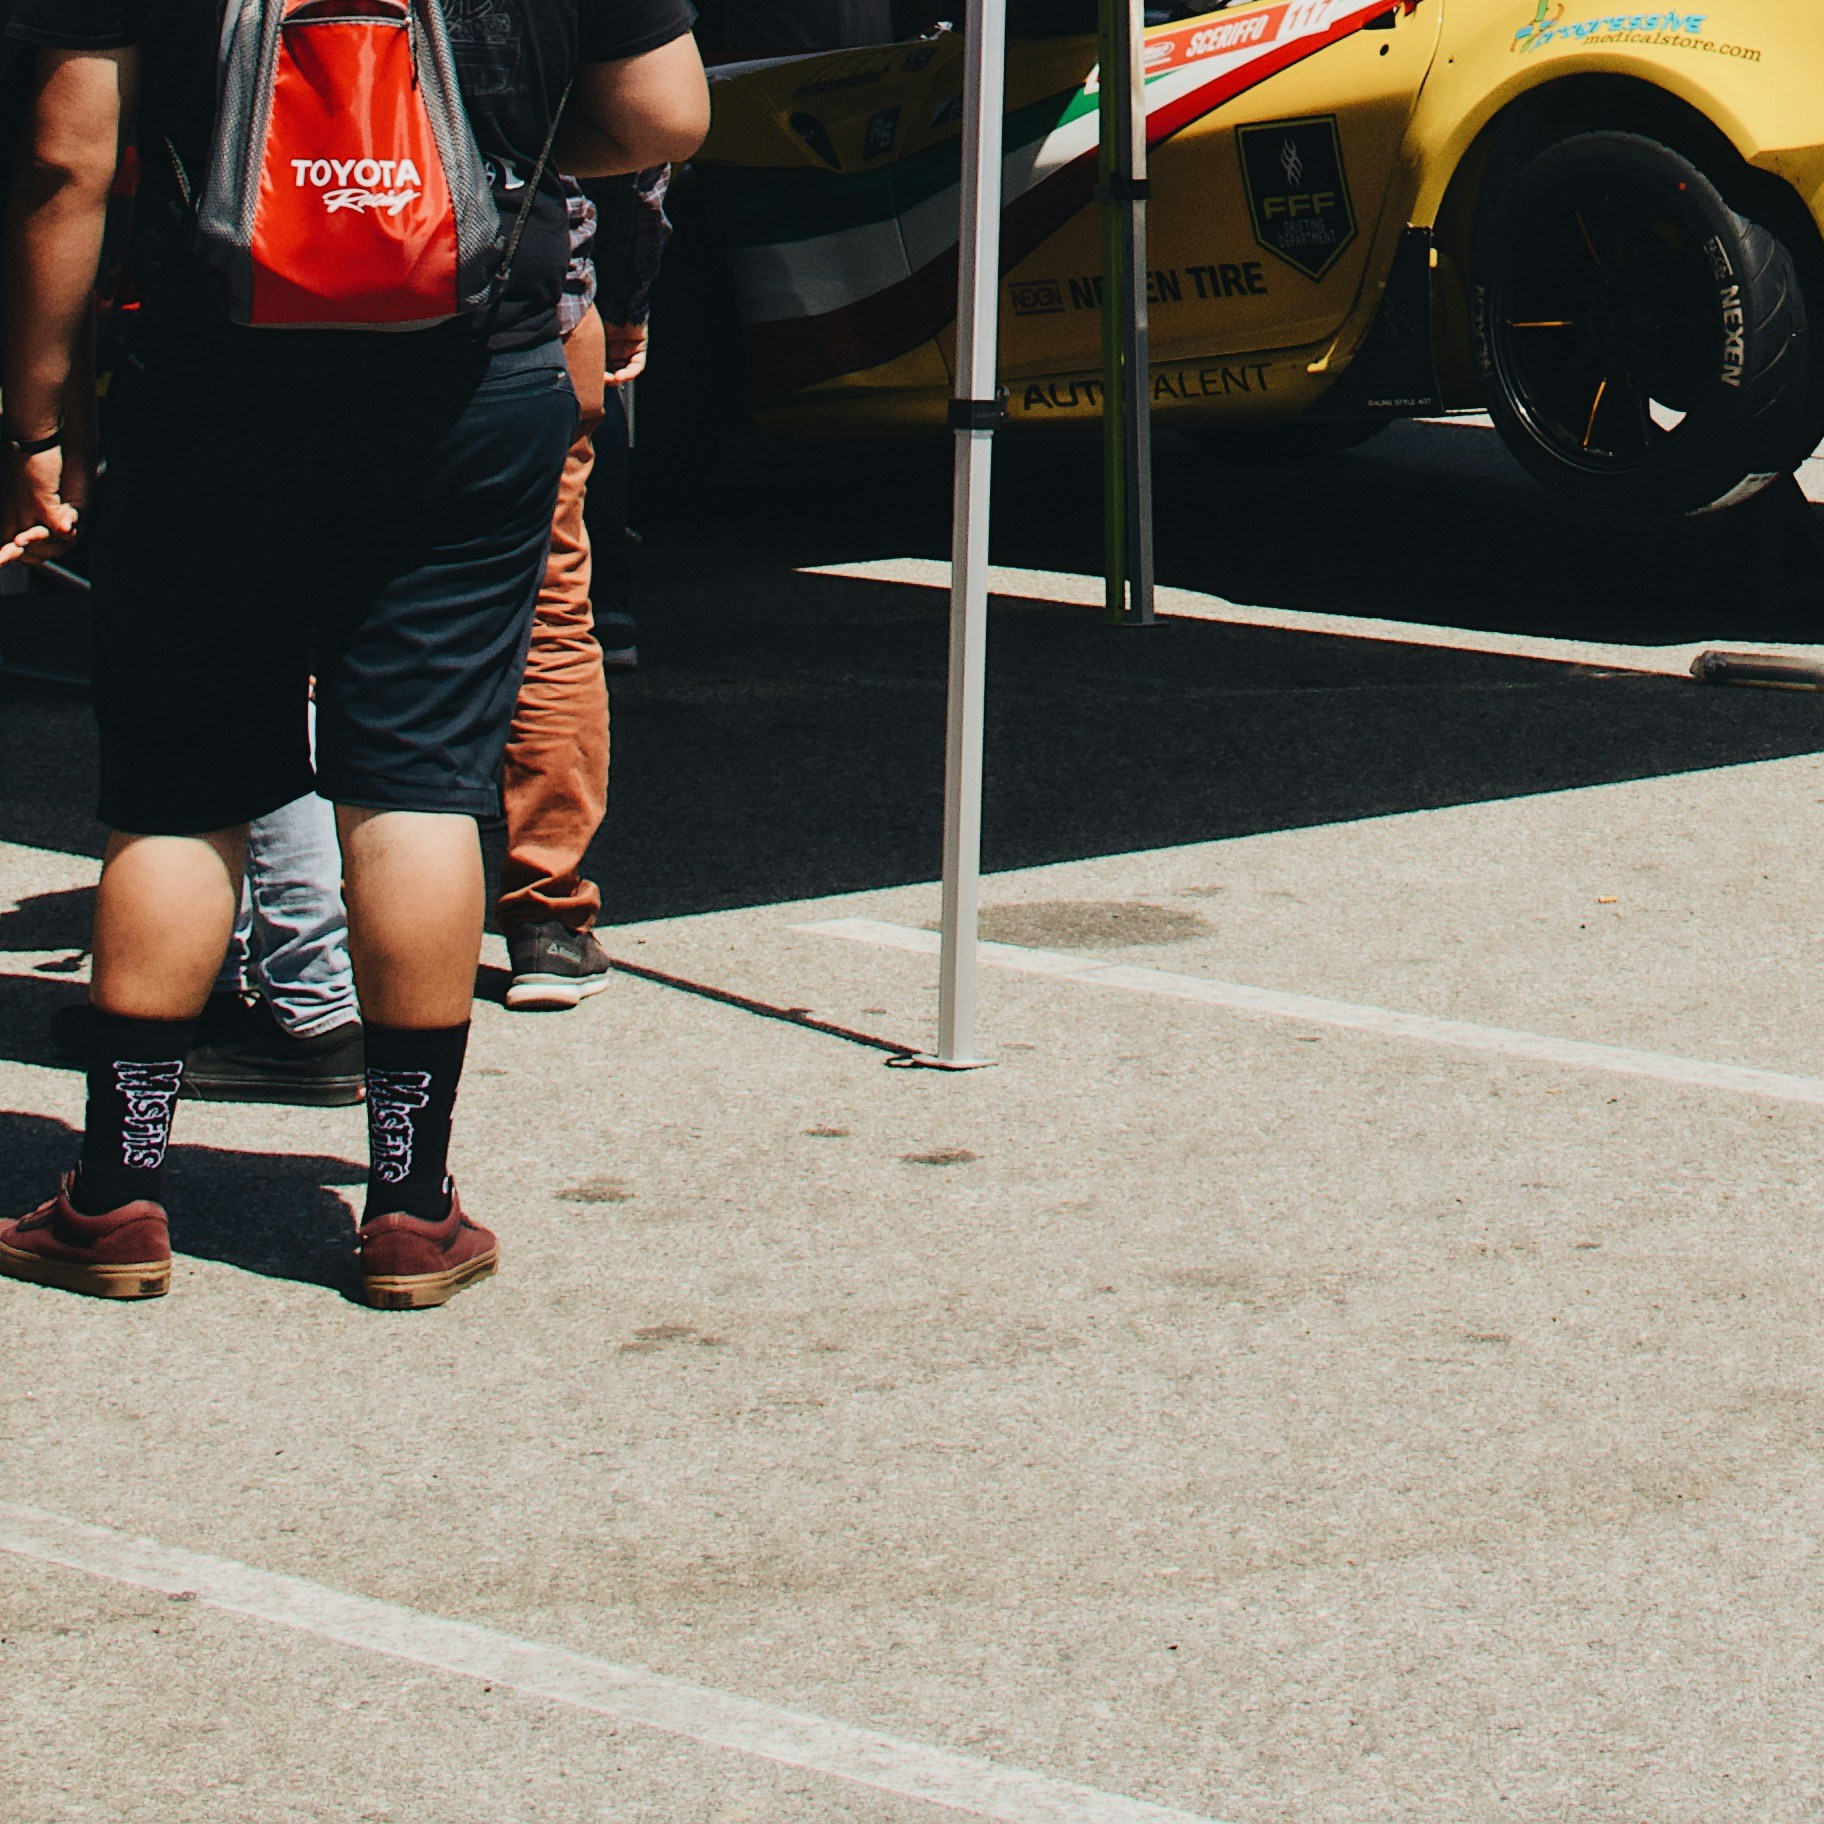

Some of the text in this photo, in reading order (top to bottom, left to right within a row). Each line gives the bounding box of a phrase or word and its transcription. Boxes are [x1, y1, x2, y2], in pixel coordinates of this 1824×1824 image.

[1184, 13, 1270, 58] SCERIFFO
[1583, 30, 1763, 63] medicalstore.com
[290, 158, 422, 188] TOYOTA
[321, 188, 422, 216] Racing
[1263, 191, 1337, 220] FFF
[1185, 260, 1268, 300] TIRE
[1719, 284, 1746, 390] NEXEN
